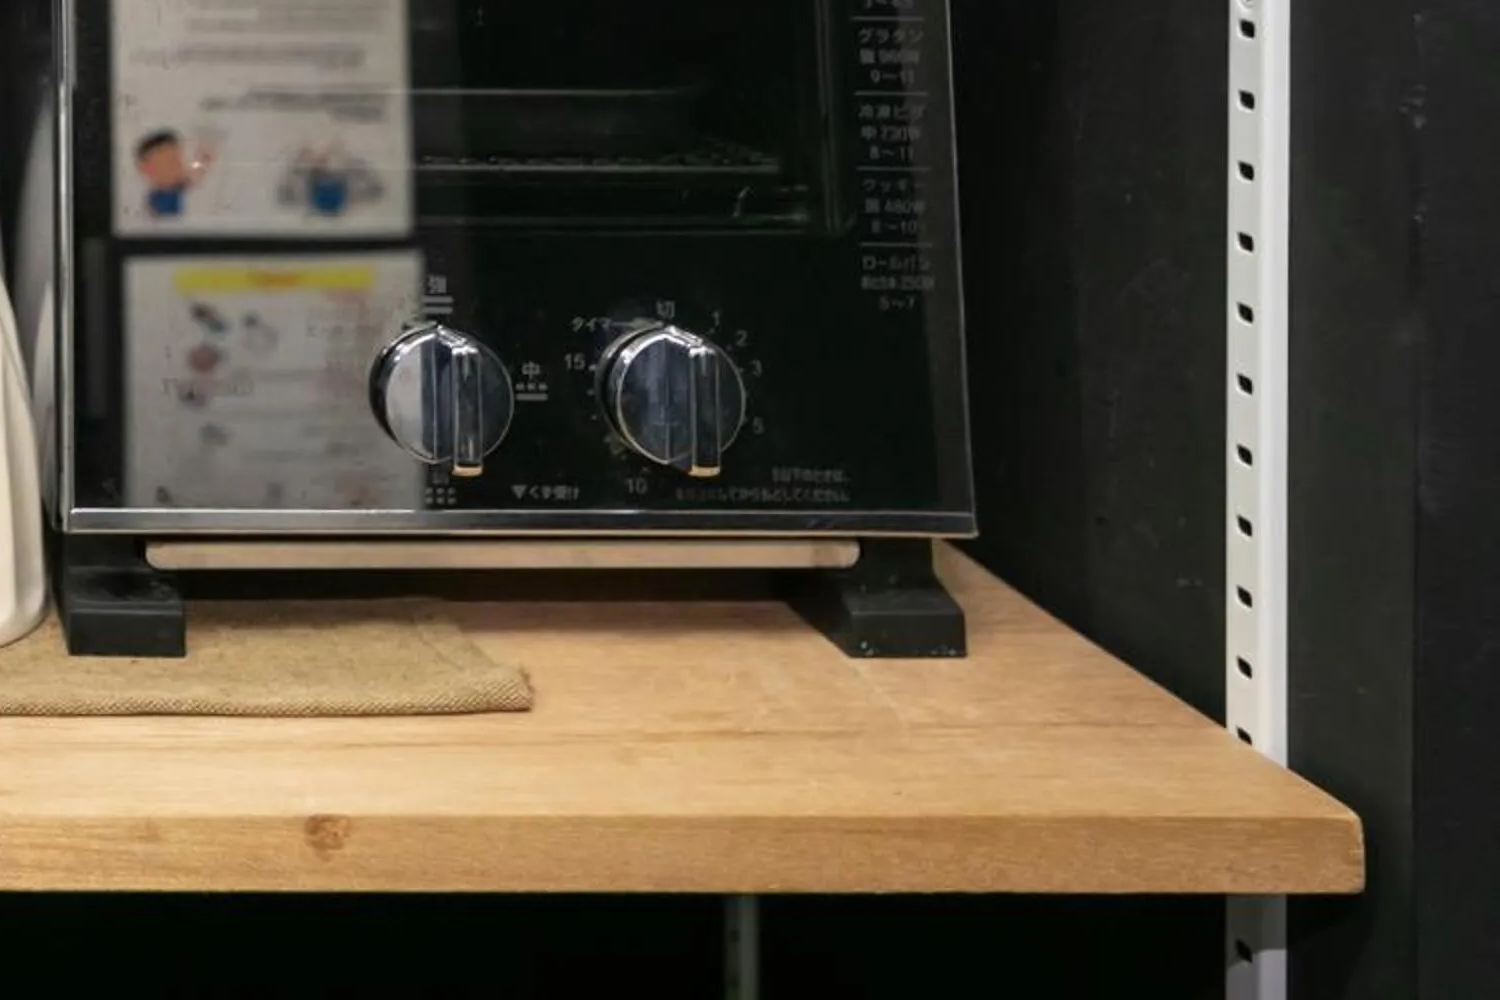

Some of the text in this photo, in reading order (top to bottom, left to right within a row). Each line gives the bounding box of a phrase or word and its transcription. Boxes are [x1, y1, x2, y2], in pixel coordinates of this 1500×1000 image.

[736, 329, 749, 347] 2
[522, 361, 541, 380] 中
[565, 353, 586, 370] 15
[750, 359, 763, 377] 3
[752, 416, 765, 435] 5
[622, 477, 648, 494] 10
